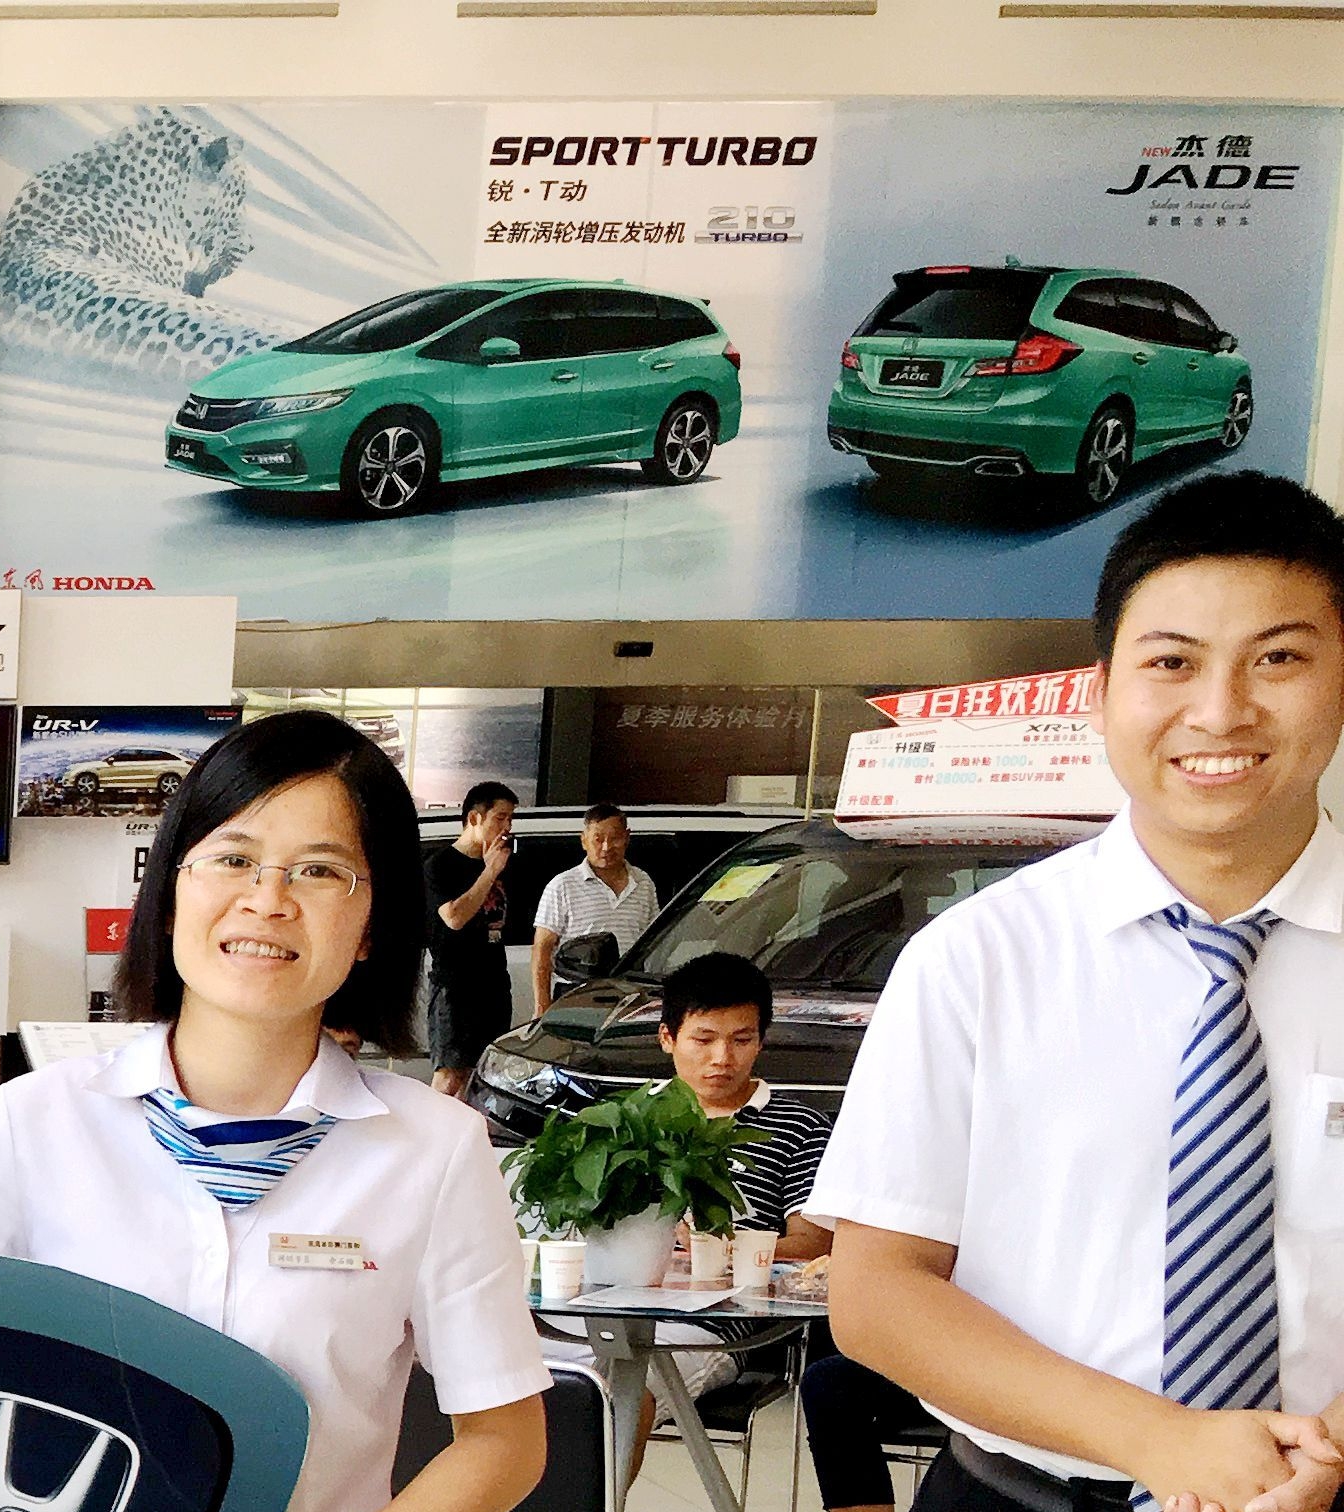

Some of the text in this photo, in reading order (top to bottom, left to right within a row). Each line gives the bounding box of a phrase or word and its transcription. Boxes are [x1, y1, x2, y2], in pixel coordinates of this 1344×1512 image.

[489, 137, 818, 165] SPORT TURBO
[1171, 134, 1253, 157] 杰德
[1105, 164, 1300, 195] JADE
[707, 206, 796, 230] 210
[484, 220, 686, 244] 全新涡轮增压发动机
[708, 232, 789, 243] TURBO
[52, 576, 155, 591] HONDA
[32, 719, 100, 731] UR-V
[616, 704, 809, 729] 夏季服务体验月
[1026, 723, 1088, 733] XR-V
